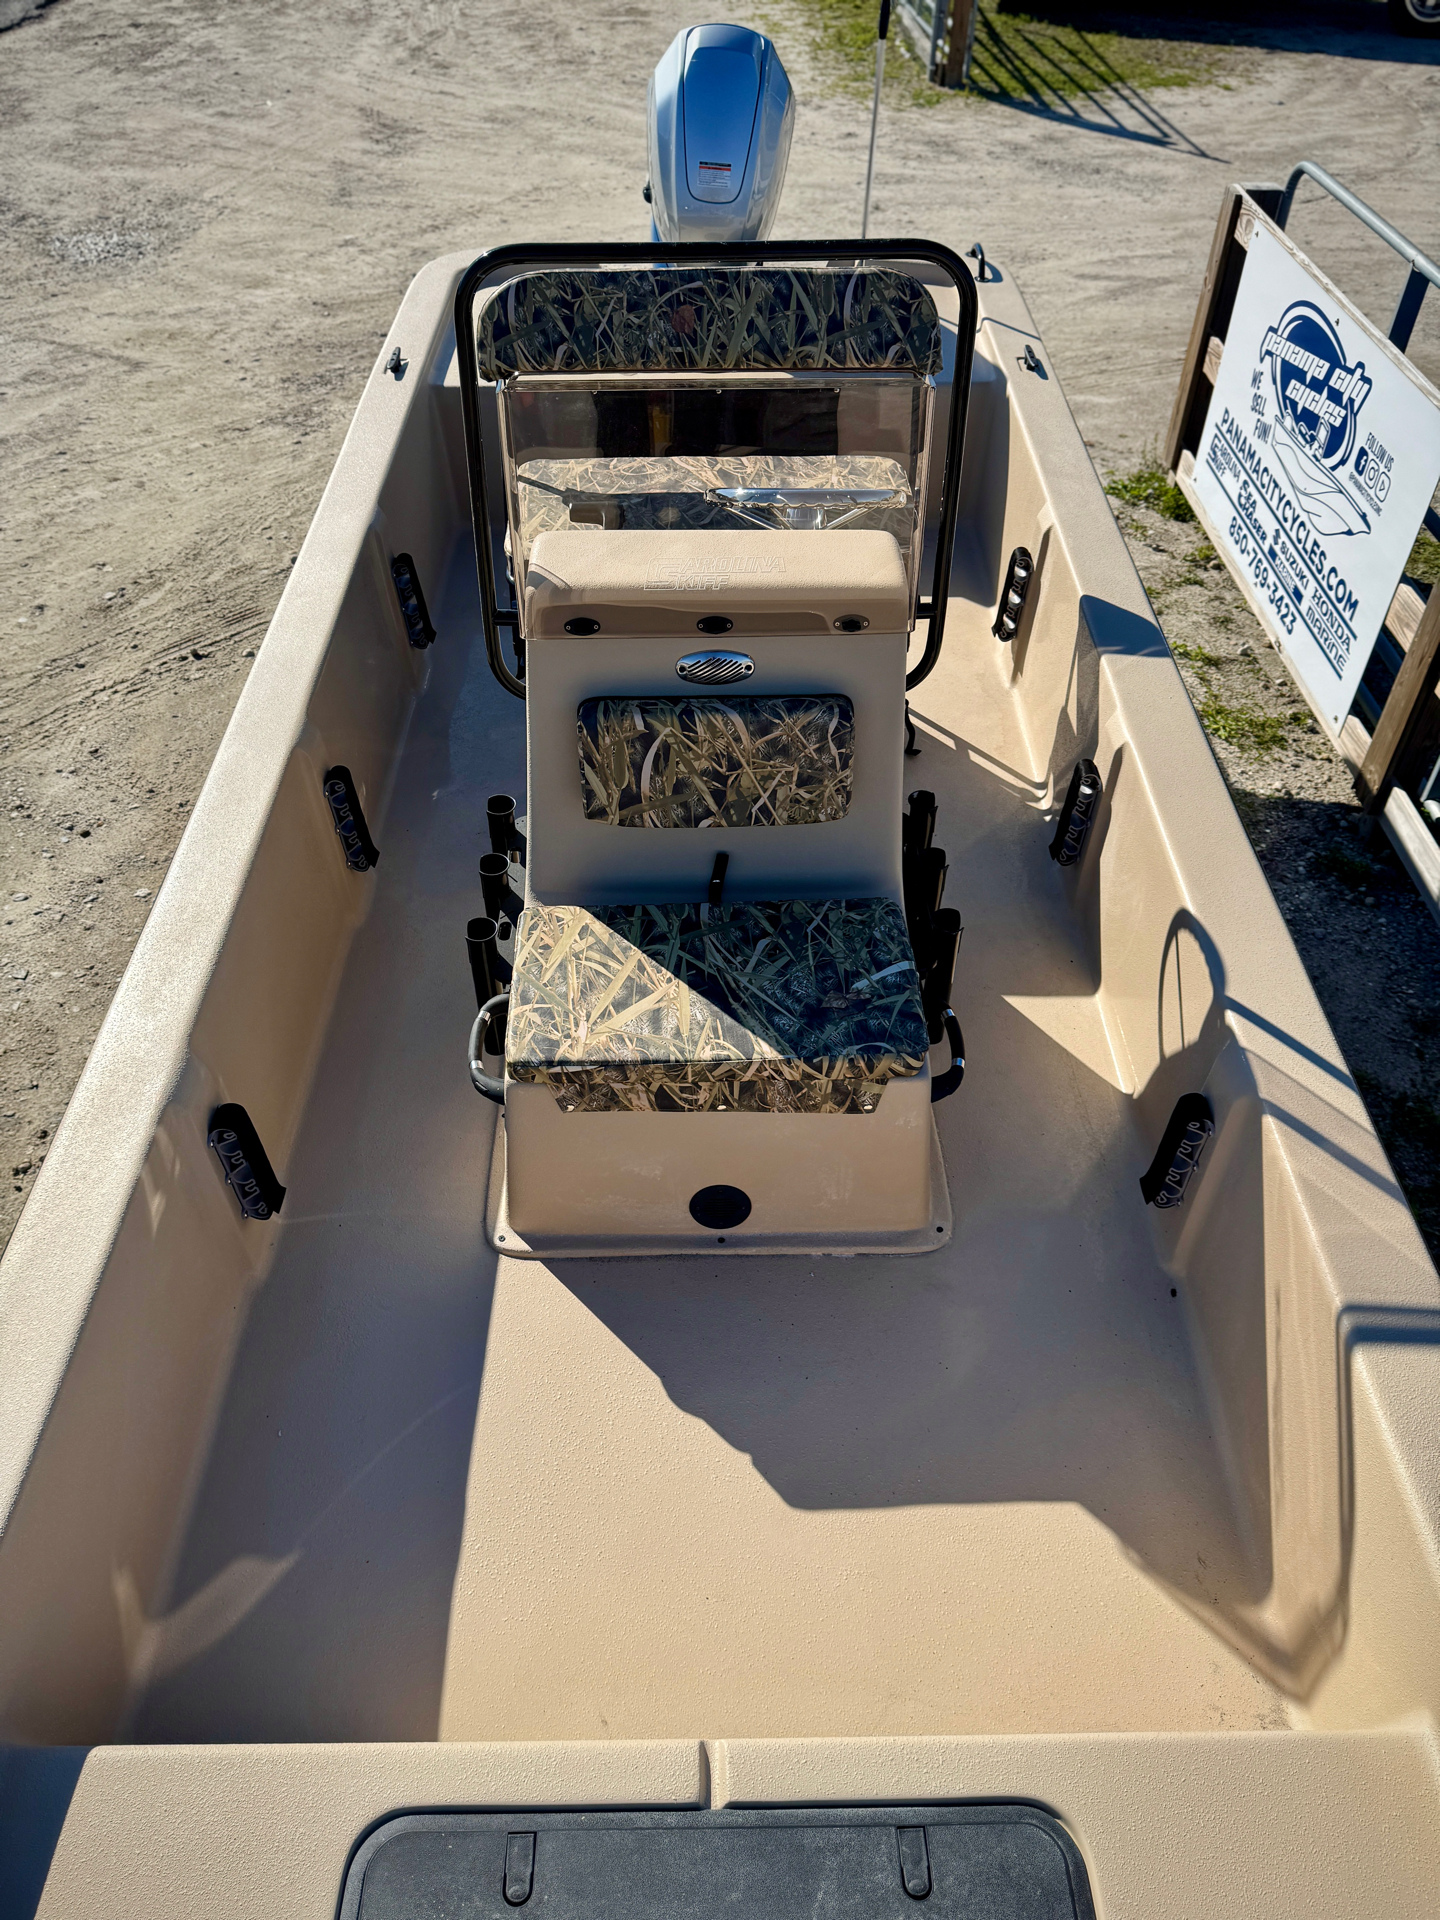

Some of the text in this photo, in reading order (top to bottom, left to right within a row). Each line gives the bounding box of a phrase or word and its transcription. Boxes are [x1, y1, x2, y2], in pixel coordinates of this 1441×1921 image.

[1251, 368, 1264, 389] WE
[1251, 392, 1267, 417] SELL
[1253, 418, 1272, 445] FUN!
[1365, 432, 1394, 472] FOLLOW US
[1220, 406, 1360, 622] PANAMACITYCYCLES.COM
[1241, 479, 1257, 513] SEA
[1237, 491, 1267, 545] CHASER
[644, 565, 730, 591] SKIFF
[647, 556, 787, 582] CAROLINA
[1229, 515, 1297, 635] 850-769-3423
[1280, 541, 1309, 590] SUZUKI
[1312, 586, 1351, 655] HONDA
